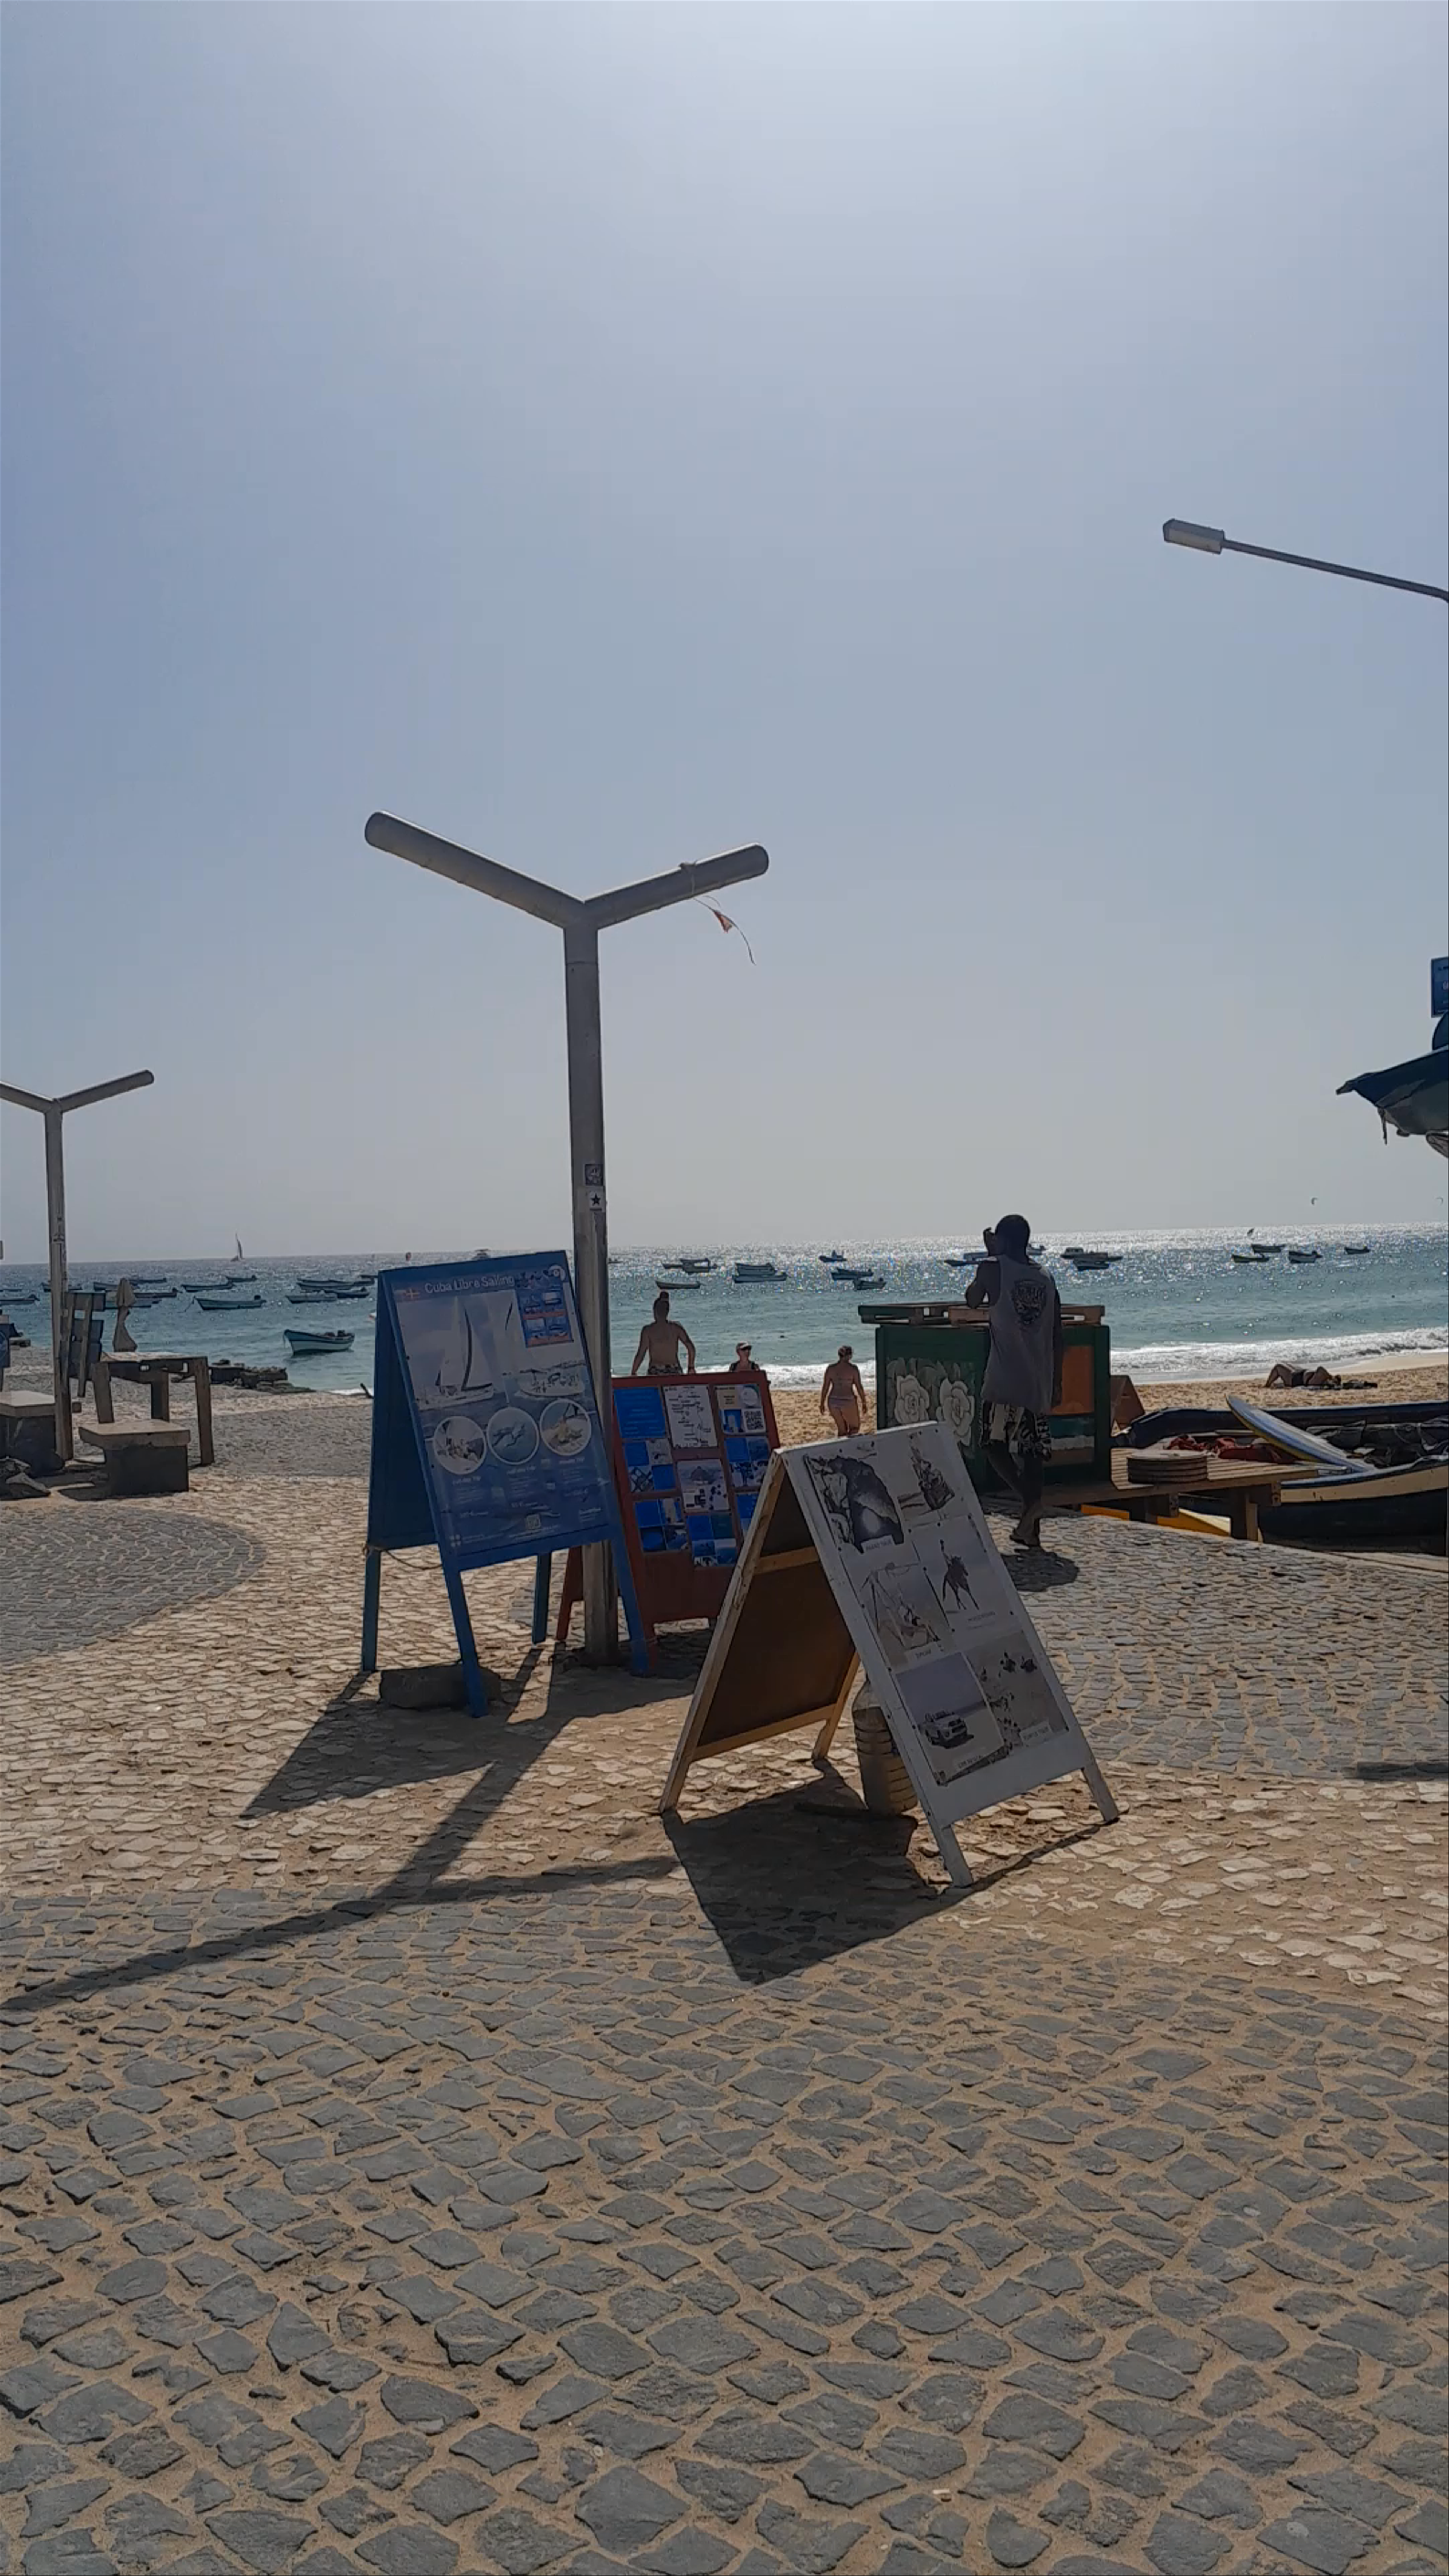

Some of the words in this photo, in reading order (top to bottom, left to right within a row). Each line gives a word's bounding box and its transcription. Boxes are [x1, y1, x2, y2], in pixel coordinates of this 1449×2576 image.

[425, 1283, 452, 1293] Cuba
[454, 1278, 480, 1291] Libre
[481, 1274, 514, 1287] Sailing
